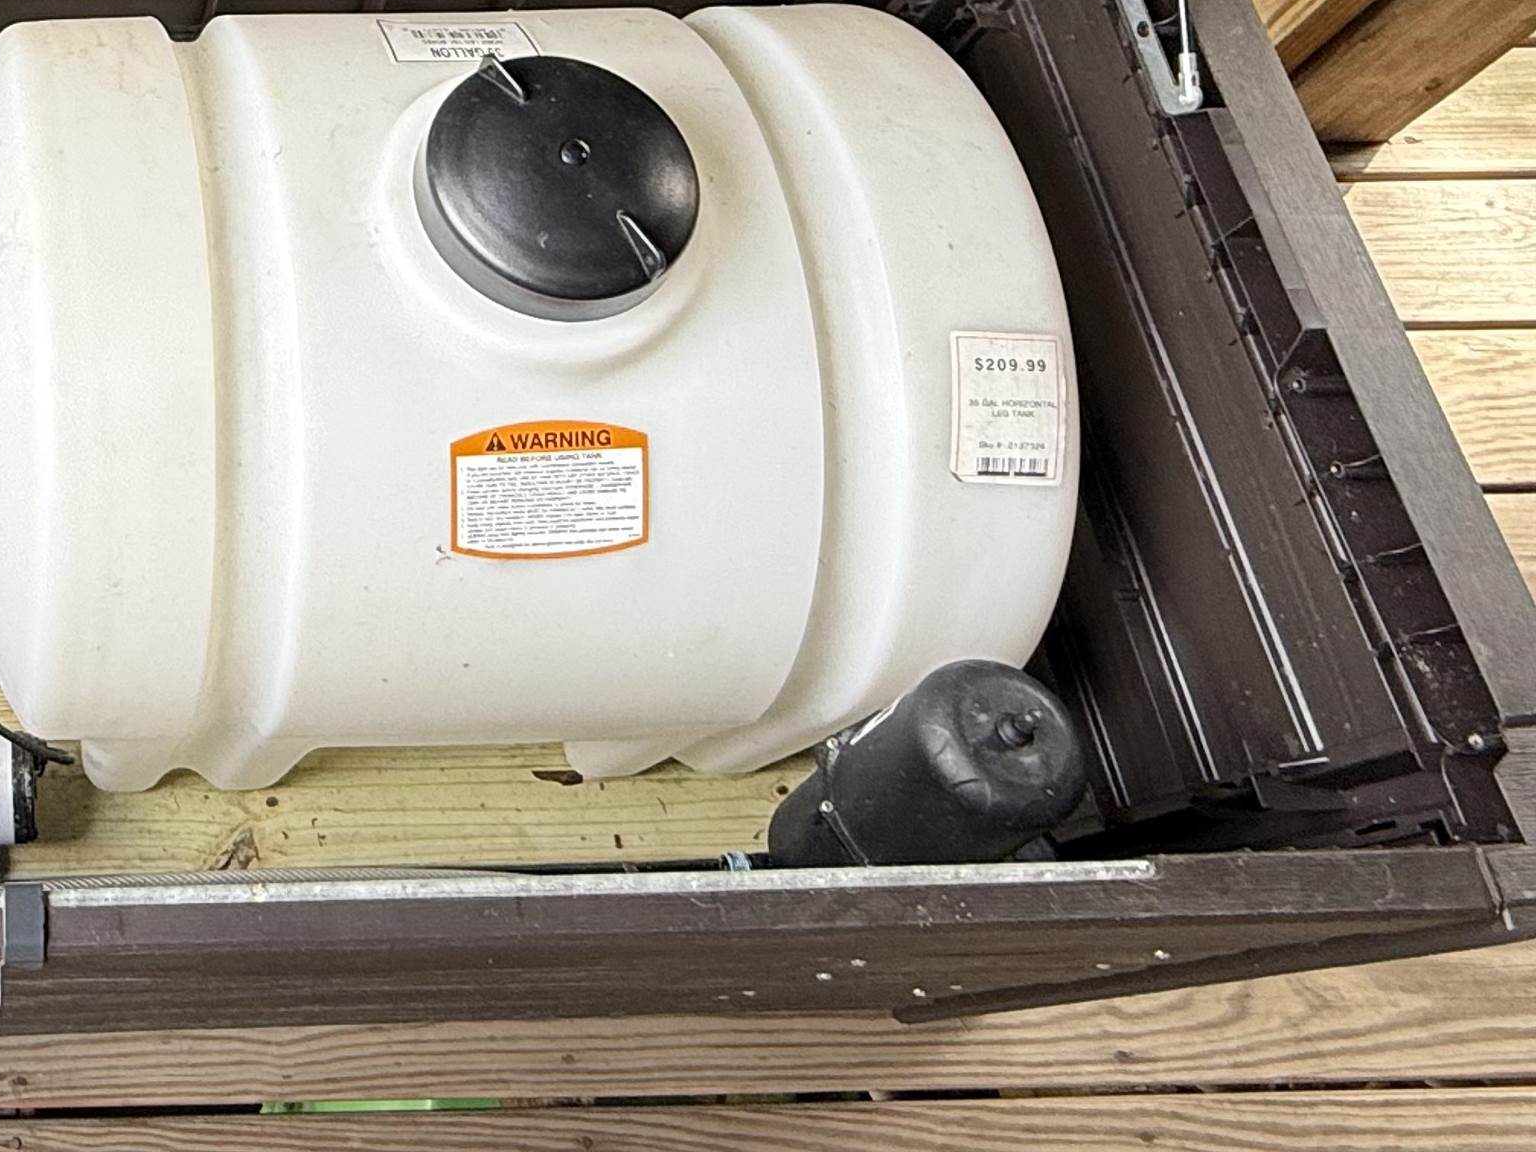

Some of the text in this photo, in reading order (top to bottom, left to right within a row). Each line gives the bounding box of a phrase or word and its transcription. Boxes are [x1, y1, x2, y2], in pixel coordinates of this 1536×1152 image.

[430, 47, 484, 58] GALLON
[974, 357, 1047, 372] $209.99
[1001, 399, 1057, 408] HORIZONTAL
[510, 429, 612, 450] WARNING
[496, 456, 518, 464] READ
[520, 455, 552, 463] BEFORE
